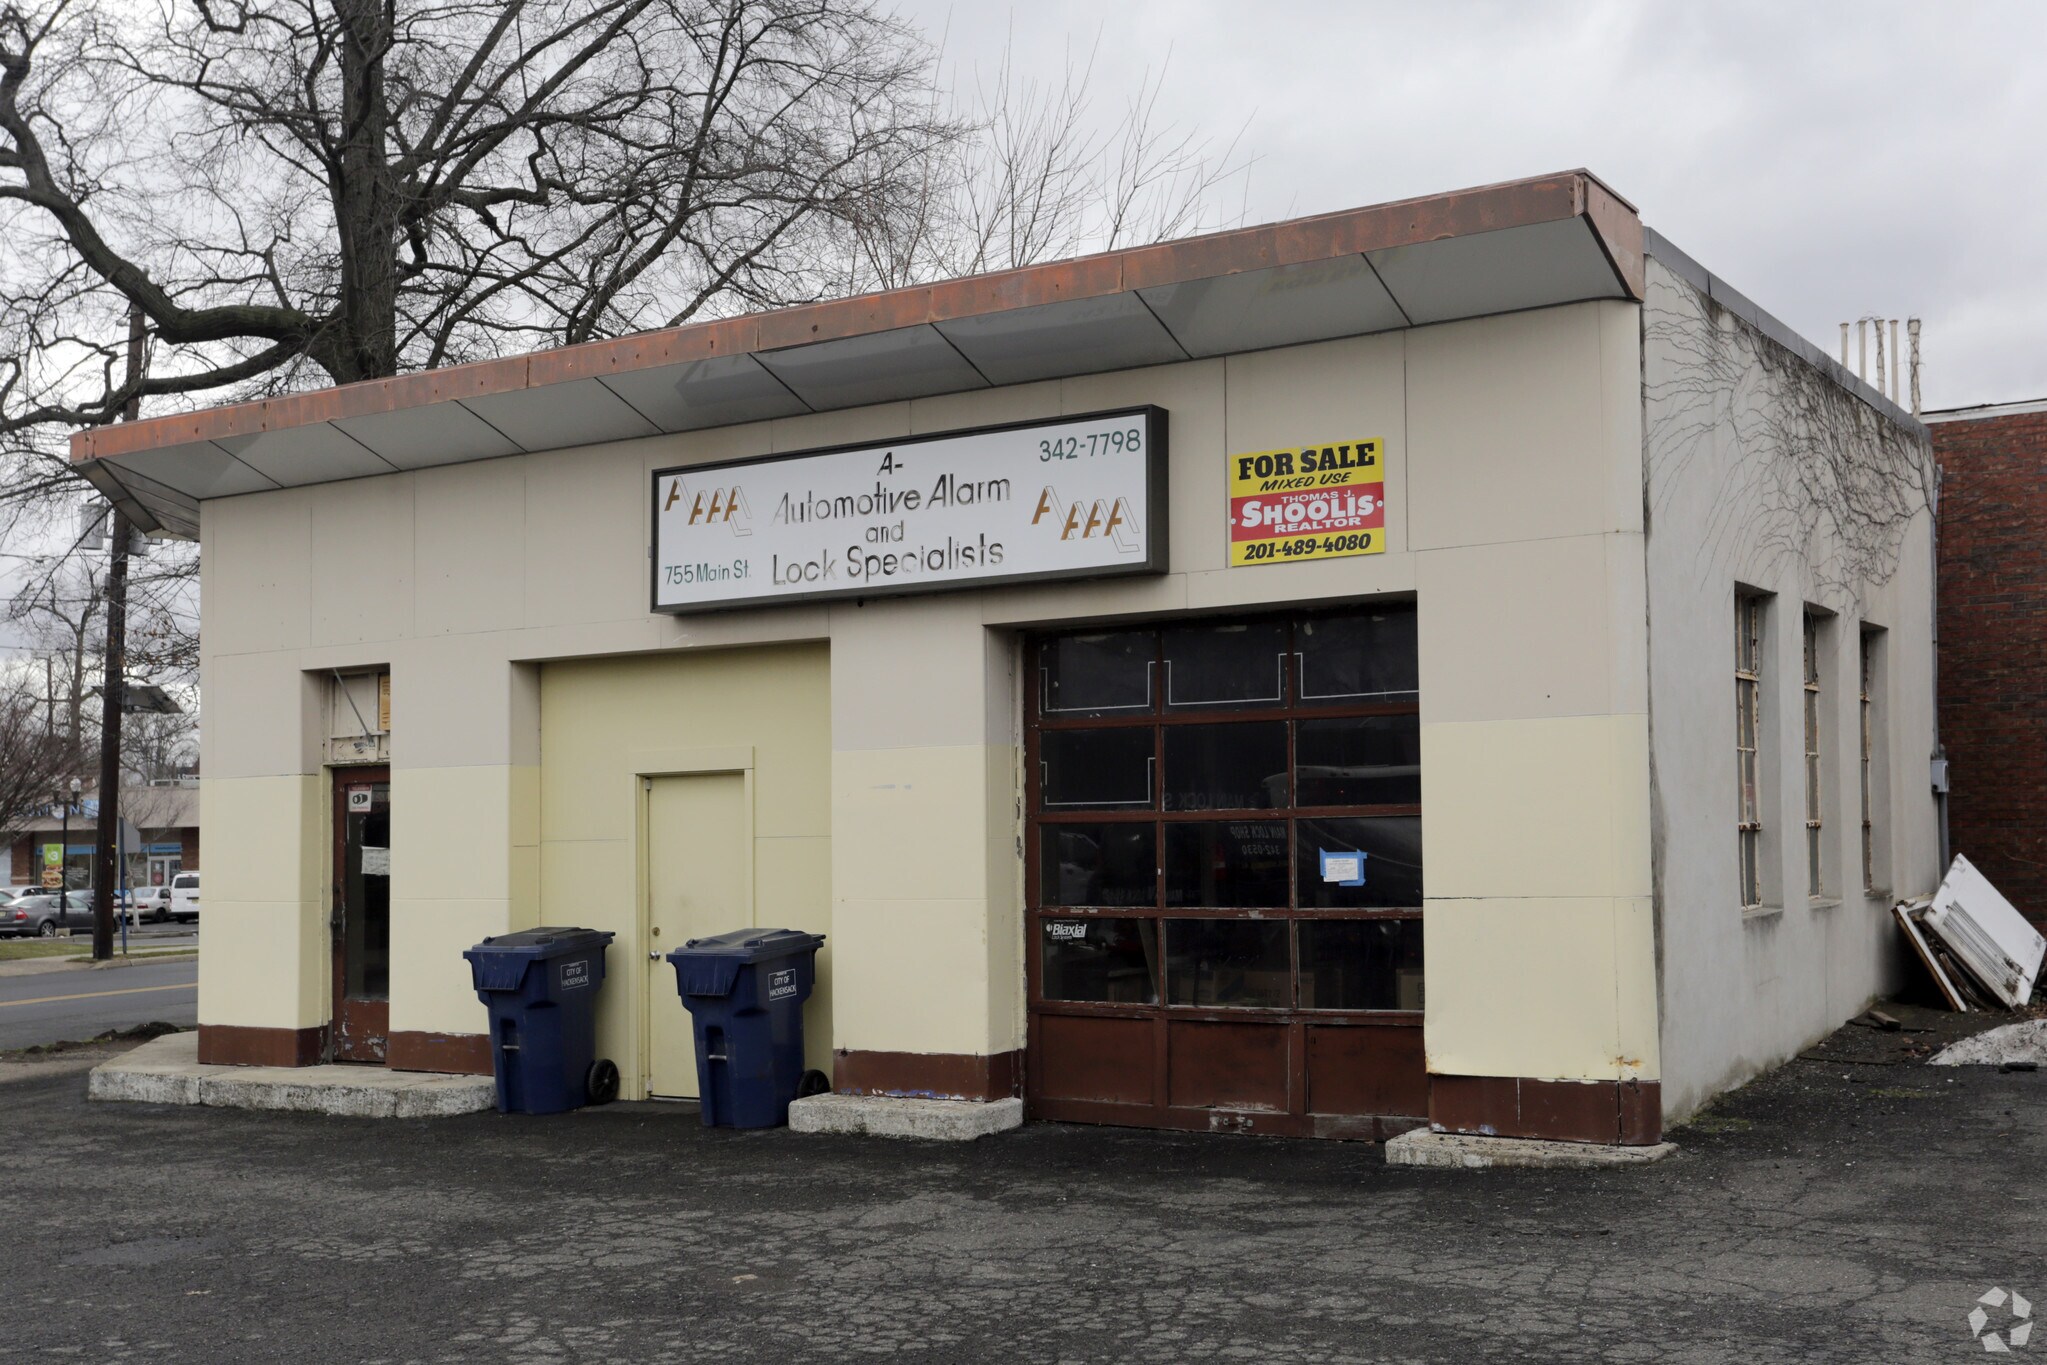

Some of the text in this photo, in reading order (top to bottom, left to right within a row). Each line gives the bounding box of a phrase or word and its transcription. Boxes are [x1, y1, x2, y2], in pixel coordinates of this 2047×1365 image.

[1040, 429, 1141, 462] 342-7798
[877, 452, 903, 476] A-
[1239, 443, 1375, 481] FOR SALE
[1260, 472, 1352, 491] MIXED USE
[770, 473, 1010, 527] Automotive Alarm
[1281, 491, 1338, 503] THOMAS
[865, 520, 904, 543] and
[1274, 517, 1361, 534] REALTOR
[1244, 533, 1371, 560] 201-489-4080
[773, 532, 1004, 585] Lock Specialists
[665, 564, 694, 585] 755
[696, 562, 730, 583] Main
[1053, 923, 1088, 938] Biaxial
[576, 966, 582, 974] OF
[774, 975, 790, 986] CITY OF
